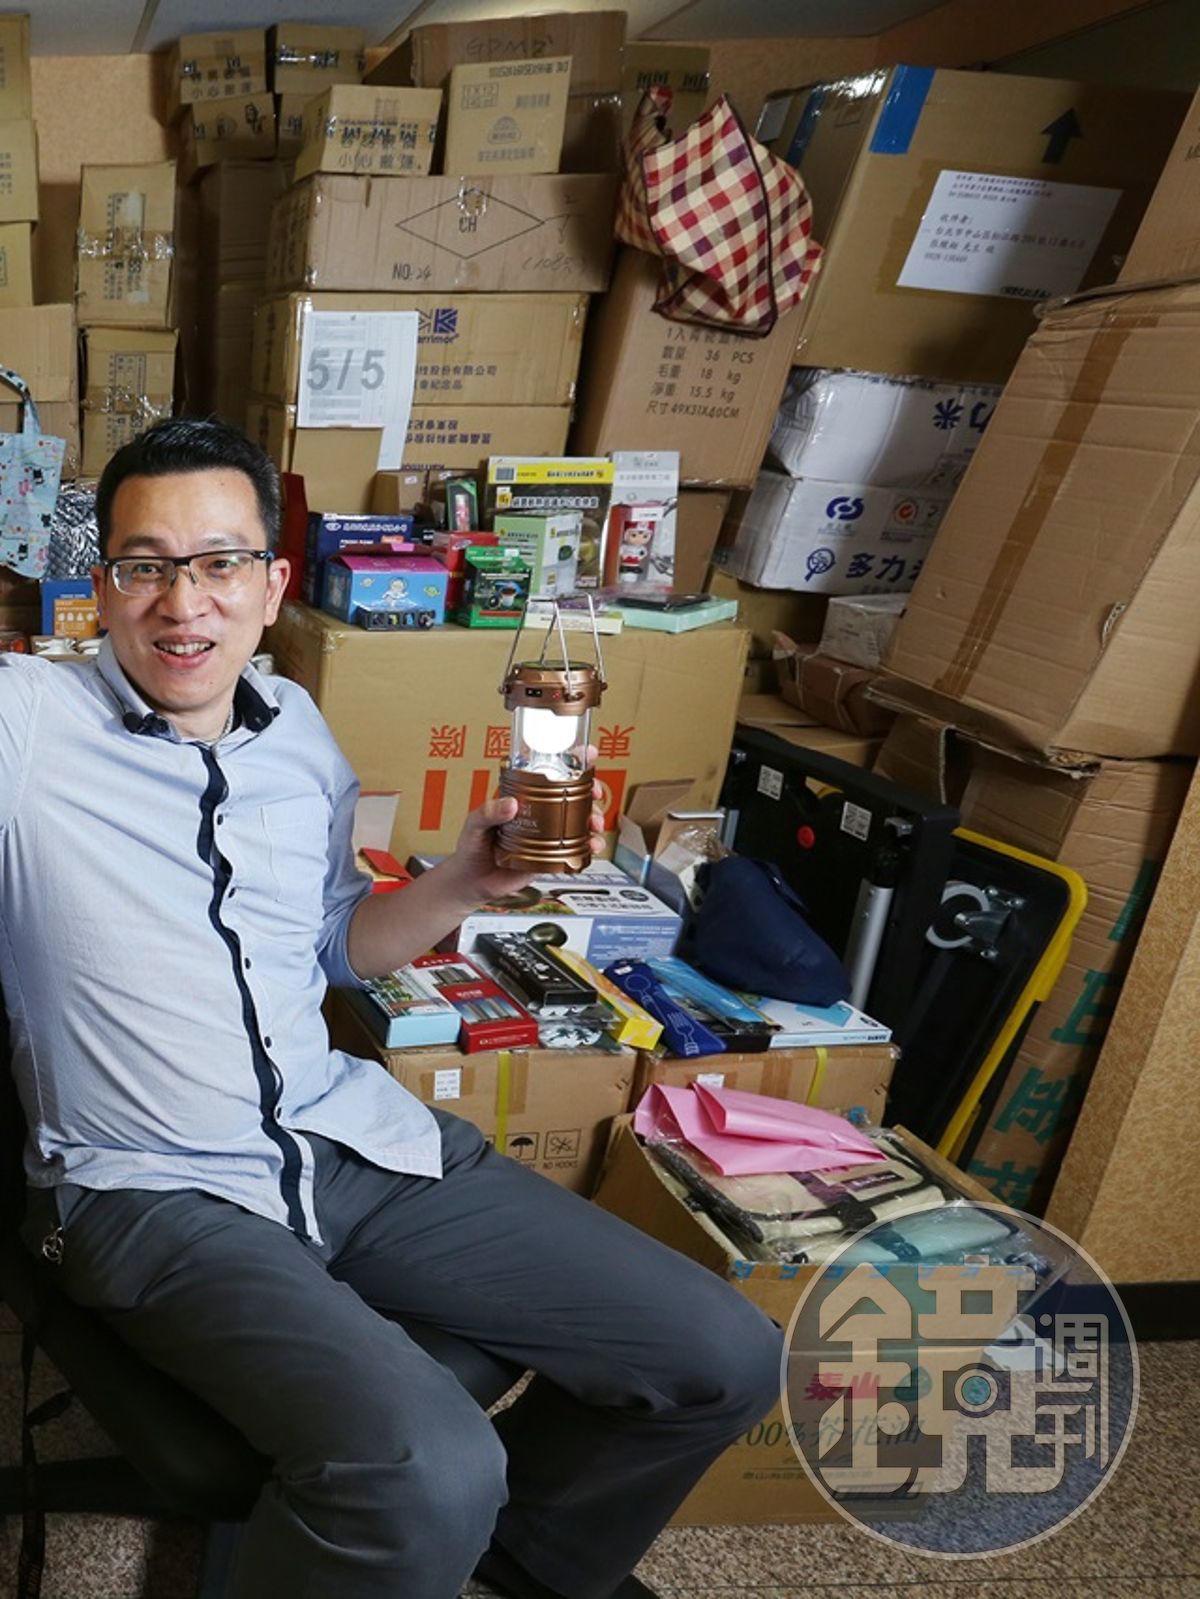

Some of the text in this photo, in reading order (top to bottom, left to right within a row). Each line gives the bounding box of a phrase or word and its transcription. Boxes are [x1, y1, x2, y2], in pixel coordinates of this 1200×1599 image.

[306, 348, 386, 391] 5/5
[705, 349, 721, 362] 36
[730, 351, 755, 365] PCS
